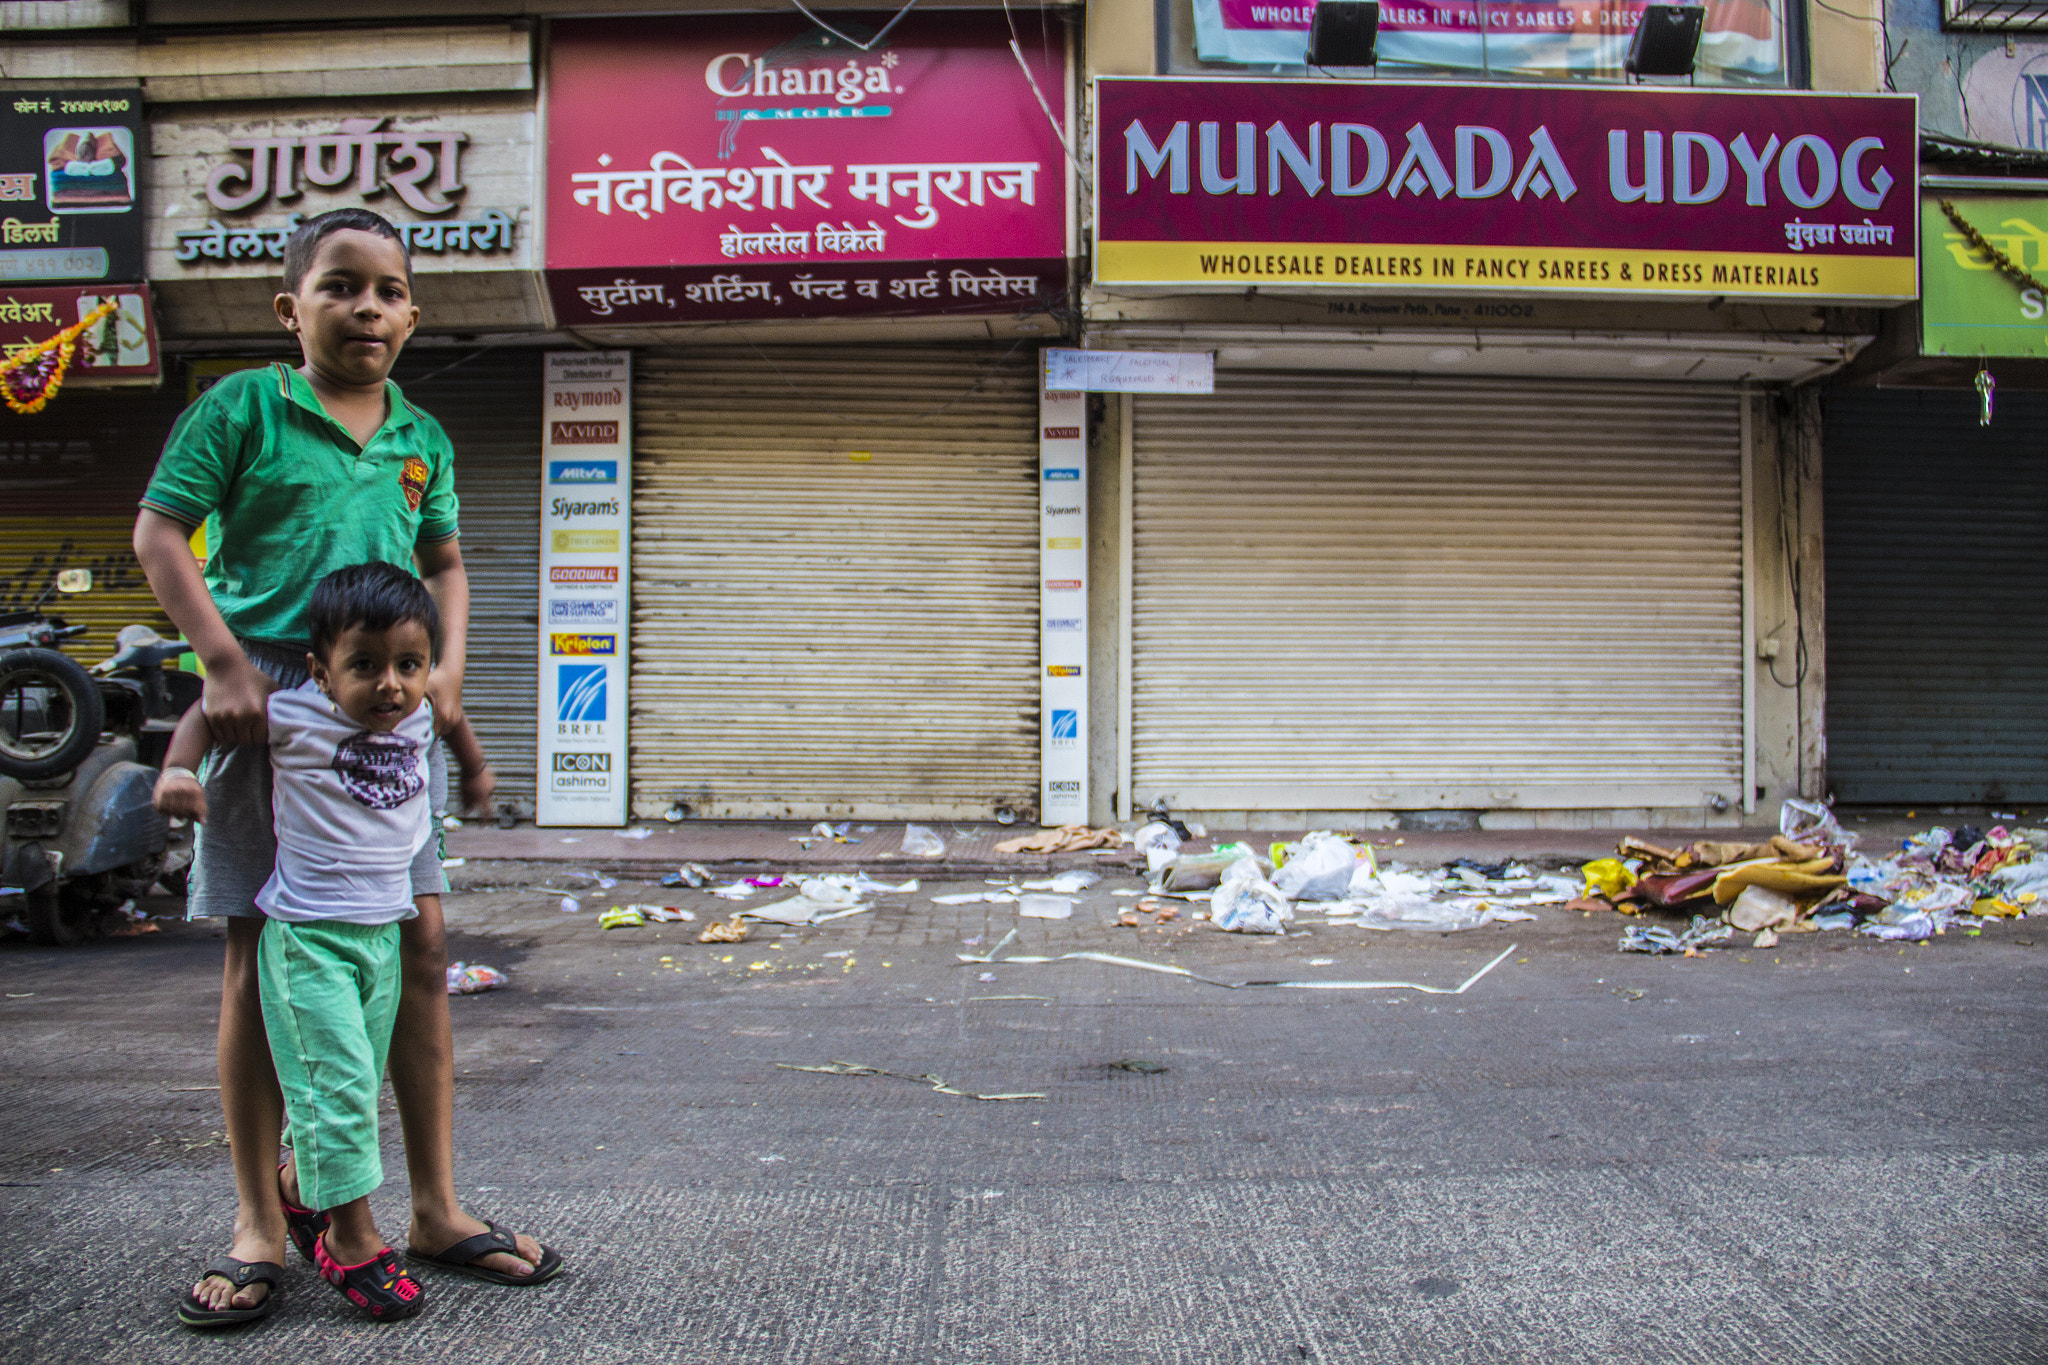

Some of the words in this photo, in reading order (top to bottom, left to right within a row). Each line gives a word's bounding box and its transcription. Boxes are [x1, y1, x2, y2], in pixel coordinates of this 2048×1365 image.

[1434, 9, 1450, 24] IN
[1516, 10, 1575, 26] SAREES
[1582, 10, 1592, 25] &
[1601, 11, 1643, 26] DRES
[13, 97, 38, 113] फोन
[205, 117, 470, 214] गणेश
[1123, 118, 1578, 202] MUNDADA
[1608, 129, 1894, 210] UDYOG
[572, 147, 832, 219] नंदकिशोर
[847, 162, 1040, 228] मनुराज
[1, 216, 60, 243] डिलर्स
[719, 224, 809, 258] होलसेल
[815, 222, 886, 254] विक्रेते
[1839, 218, 1895, 245] उद्योग
[856, 279, 879, 299] व
[889, 271, 941, 299] शर्ट
[949, 268, 1038, 295] पिसेस
[1200, 254, 1324, 275] WHOLESALE
[1335, 256, 1423, 276] DEALERS
[1433, 258, 1454, 277] IN
[1465, 258, 1530, 279] FANCY
[1538, 259, 1610, 281] SAREES
[1620, 262, 1632, 281] &
[1643, 263, 1703, 283] DRESS
[1712, 265, 1820, 286] MATERIALS
[554, 387, 622, 411] Raymond
[551, 497, 620, 520] Siyaram's
[552, 568, 616, 580] GOODWILL
[556, 754, 607, 771] ICON
[556, 775, 607, 787] ashima
